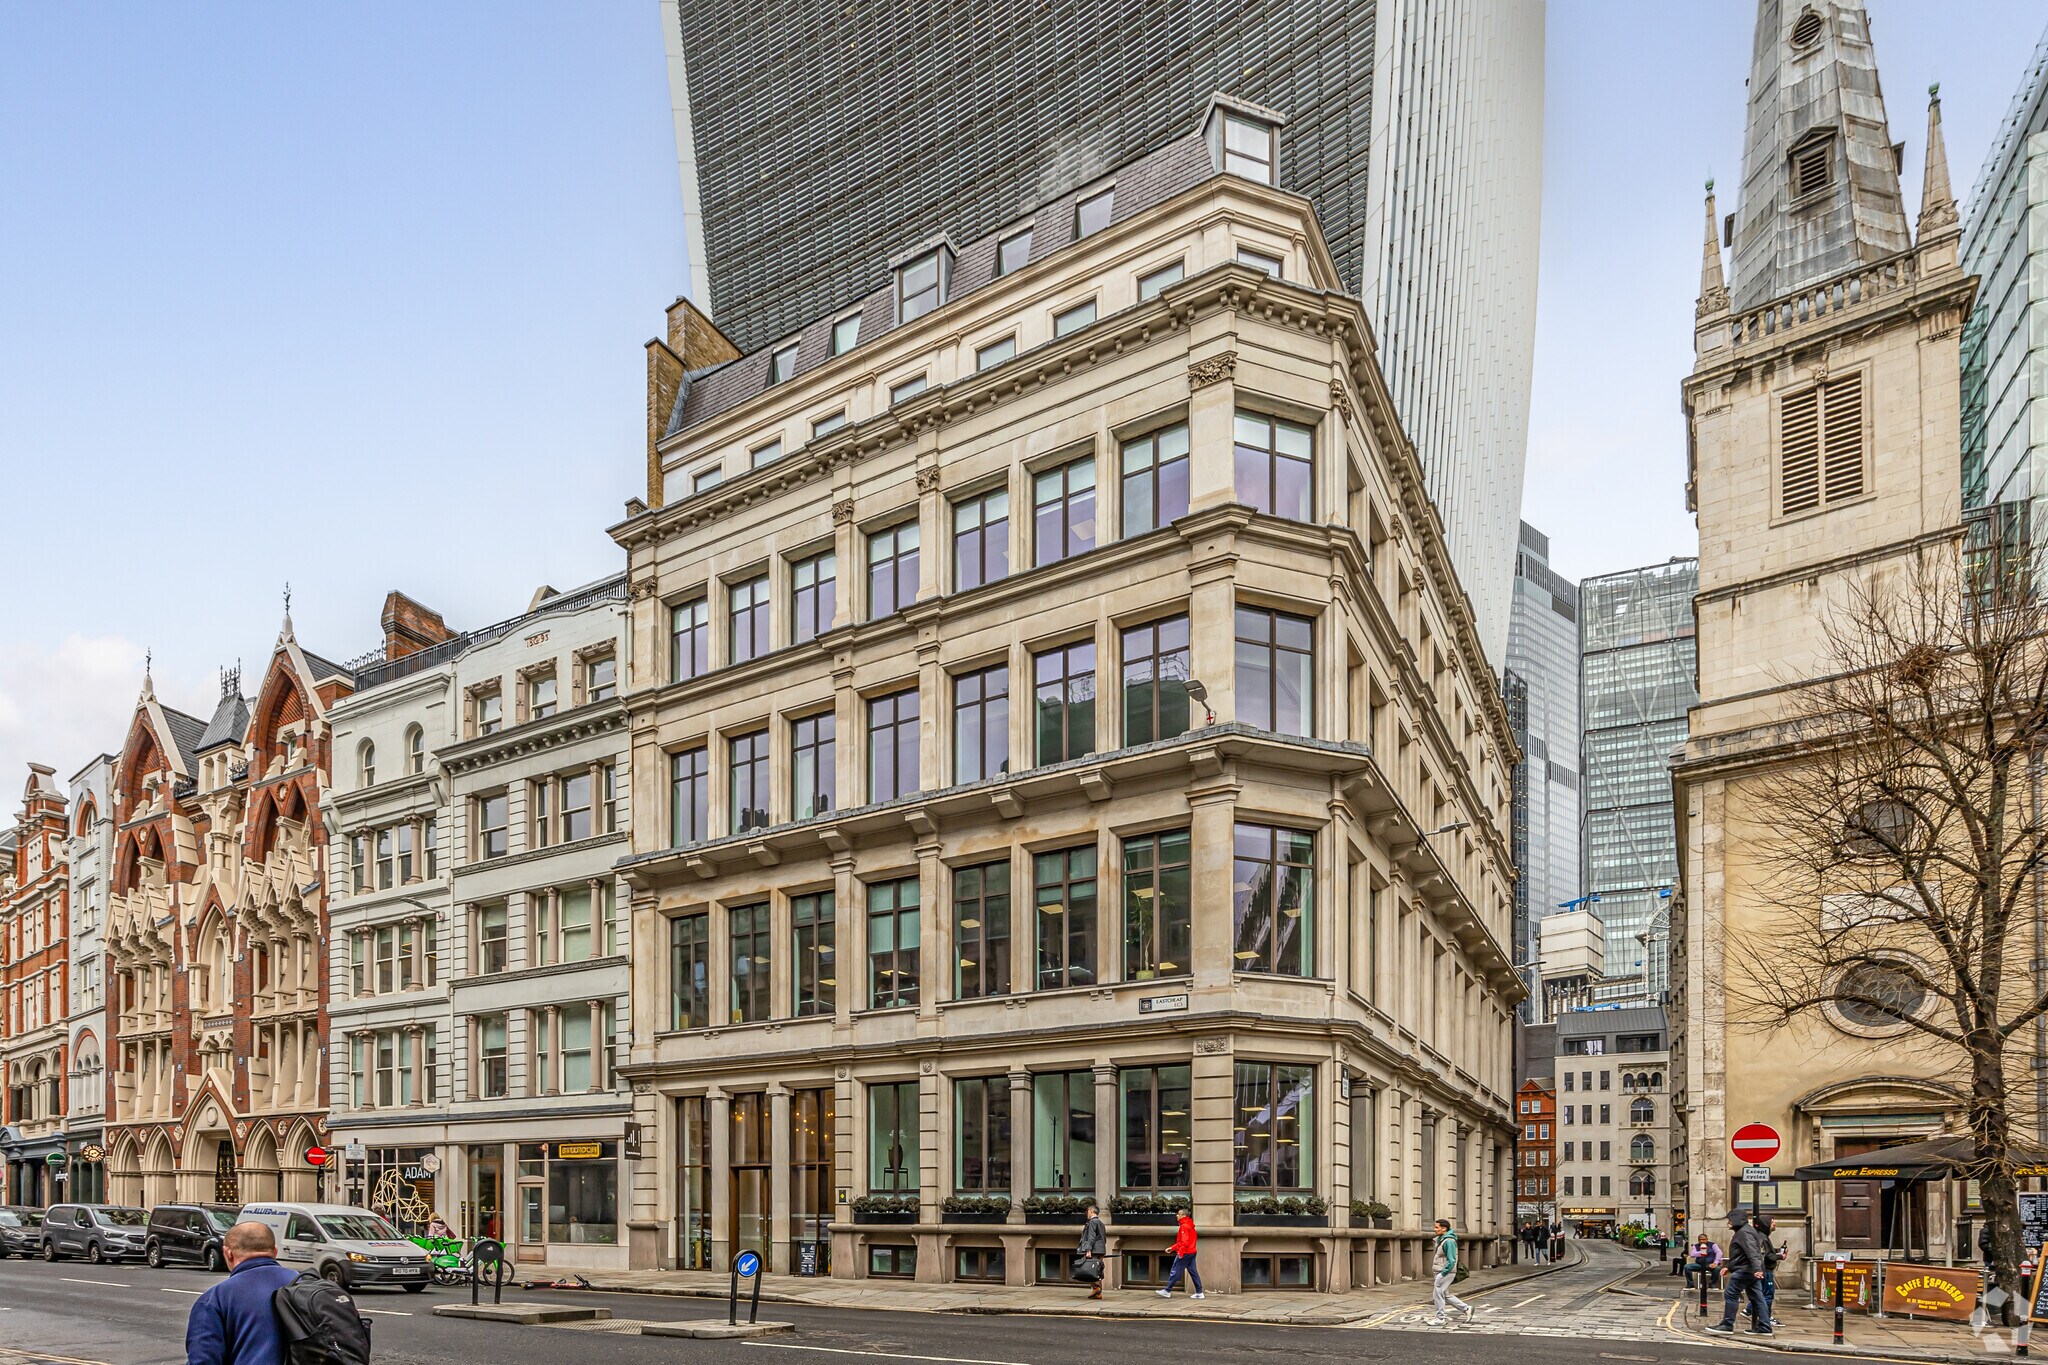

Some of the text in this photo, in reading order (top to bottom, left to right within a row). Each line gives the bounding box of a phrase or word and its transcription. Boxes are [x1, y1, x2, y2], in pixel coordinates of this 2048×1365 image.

[404, 1167, 432, 1179] ADAM
[1834, 1167, 1898, 1177] CAFFE ESPRESSO
[1896, 1275, 1966, 1302] CAFFE ESPRESSO
